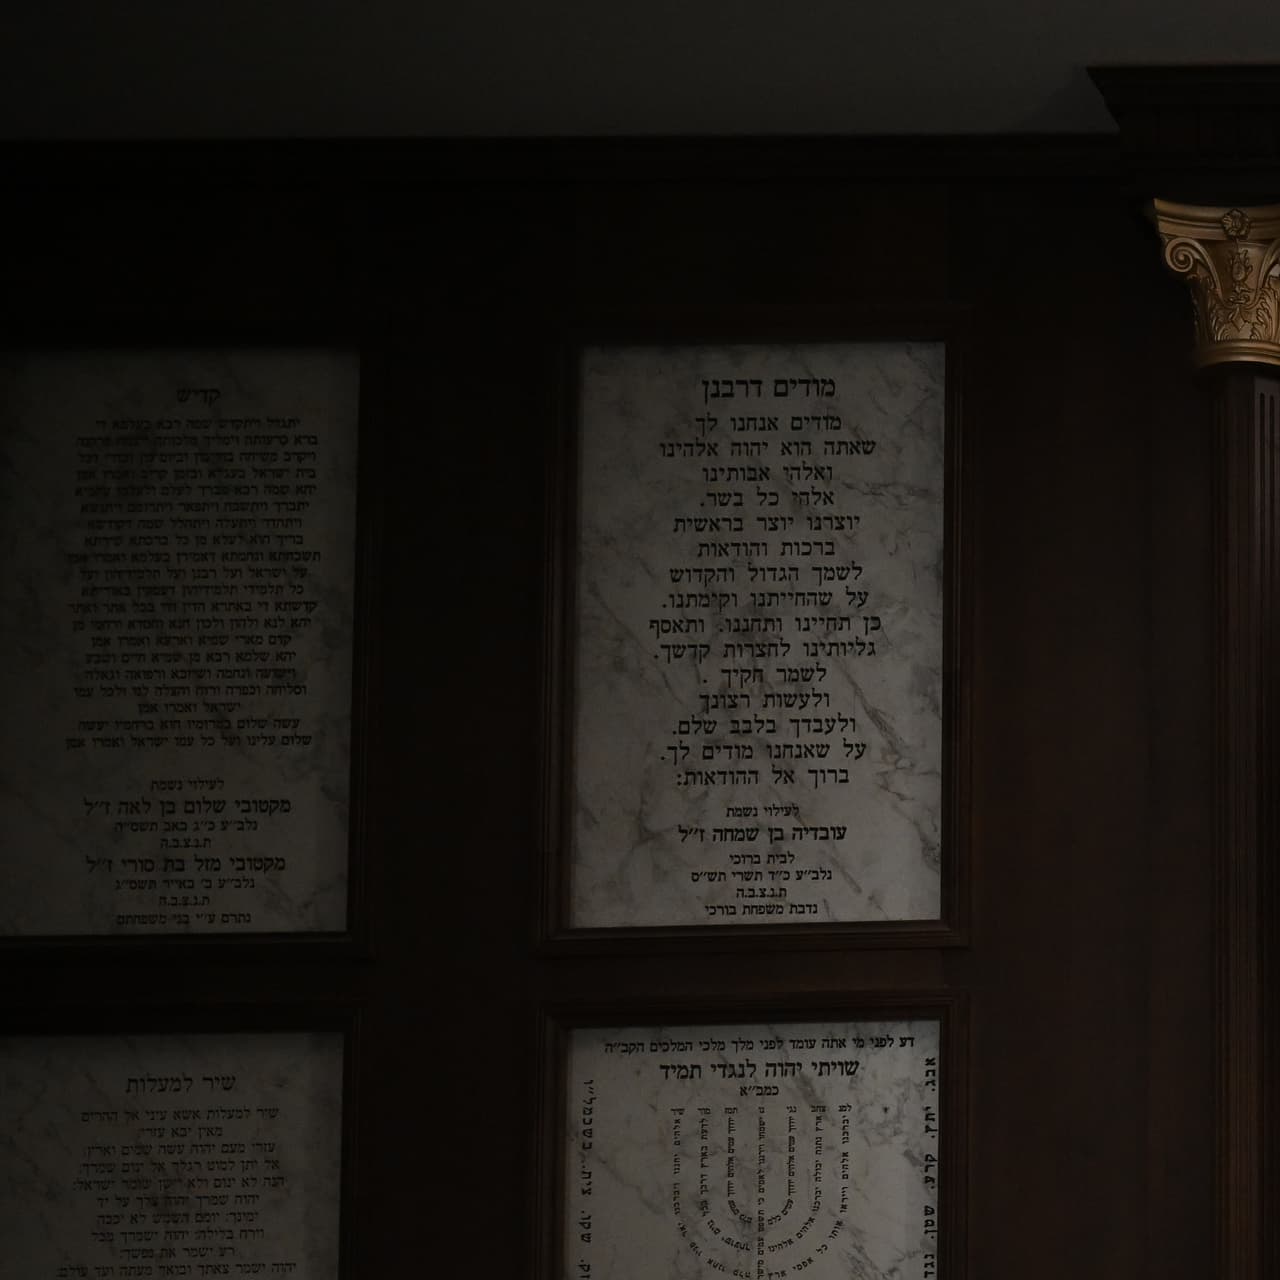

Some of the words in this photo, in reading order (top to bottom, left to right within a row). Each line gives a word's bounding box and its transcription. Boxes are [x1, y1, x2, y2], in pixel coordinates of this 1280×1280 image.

[701, 378, 763, 406] דרבנן
[773, 376, 836, 398] מודים
[695, 411, 718, 438] לך
[729, 416, 779, 432] אנחנו
[790, 413, 842, 432] מודים
[659, 436, 719, 458] אלהינו
[730, 440, 769, 457] יהוה
[780, 440, 812, 457] הוא
[823, 439, 877, 456] שאתה
[701, 465, 771, 483] אבותינו
[782, 460, 833, 485] ואלהי
[755, 485, 780, 507] כל
[791, 485, 835, 507] אלהי
[672, 516, 744, 533] בראשית
[756, 515, 794, 532] יוצר
[806, 515, 861, 531] יוצרנו
[696, 541, 768, 558] והודאות
[779, 540, 836, 557] ברכות
[669, 566, 735, 589] והקדוש
[747, 561, 800, 583] הגדול
[811, 559, 863, 587] לשמך
[749, 591, 833, 610] שהחייתנו
[845, 585, 870, 609] על
[649, 1038, 694, 1053] המלכים
[698, 1037, 726, 1052] מלכי
[730, 1036, 754, 1054] מלך
[759, 1035, 786, 1051] לפני
[788, 1038, 817, 1050] עומד
[821, 1035, 847, 1049] אתה
[851, 1035, 865, 1049] מי
[868, 1033, 895, 1049] לפני
[898, 1036, 916, 1048] דע
[659, 1063, 702, 1081] תמיד
[710, 1057, 757, 1079] לנגדי
[764, 1061, 803, 1078] יהוה
[810, 1059, 861, 1077] שויתי
[125, 1071, 194, 1095] למעלות
[201, 1074, 237, 1092] שיר
